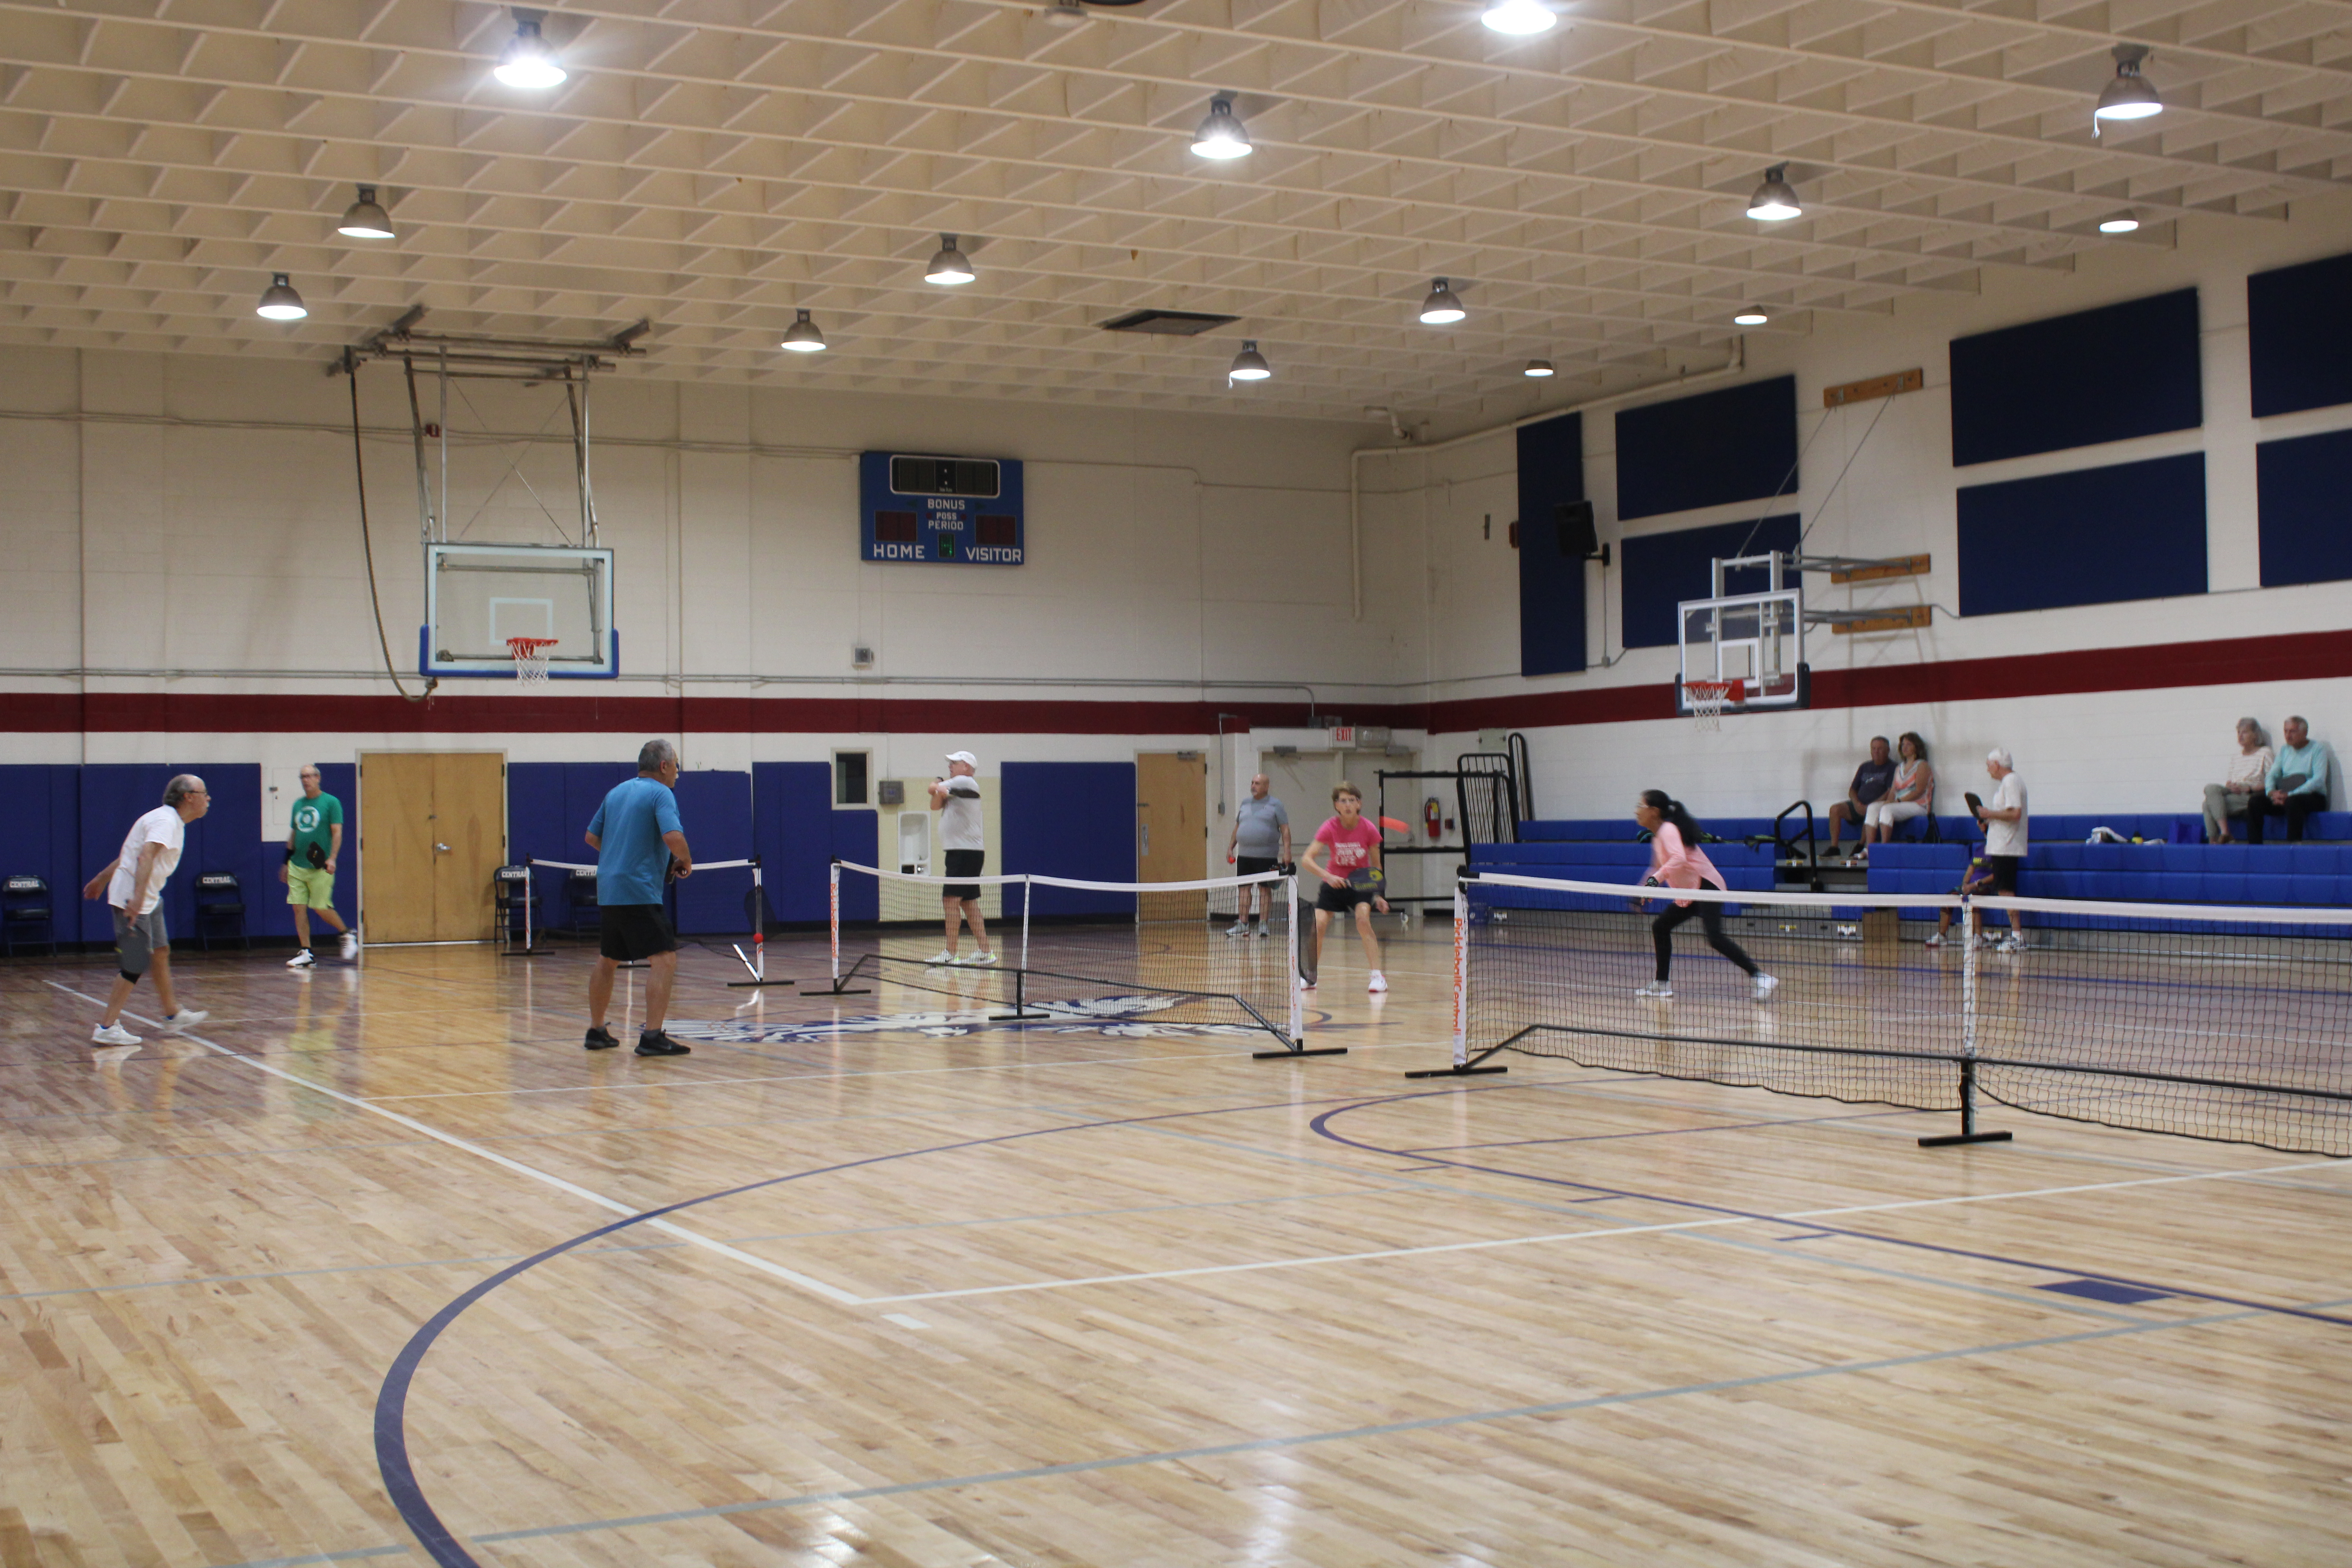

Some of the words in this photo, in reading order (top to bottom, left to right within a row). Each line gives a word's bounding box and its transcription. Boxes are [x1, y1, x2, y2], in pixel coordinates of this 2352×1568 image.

[927, 498, 965, 510] BONUS
[936, 512, 957, 521] POSS
[928, 520, 964, 531] PERIOD
[873, 543, 925, 559] HOME
[965, 546, 1021, 562] VISITOR
[1337, 727, 1352, 741] EXIT
[9, 880, 39, 888] CENTRAL
[202, 876, 230, 884] CENTRAL
[1453, 917, 1463, 1032] PickleballCentral
